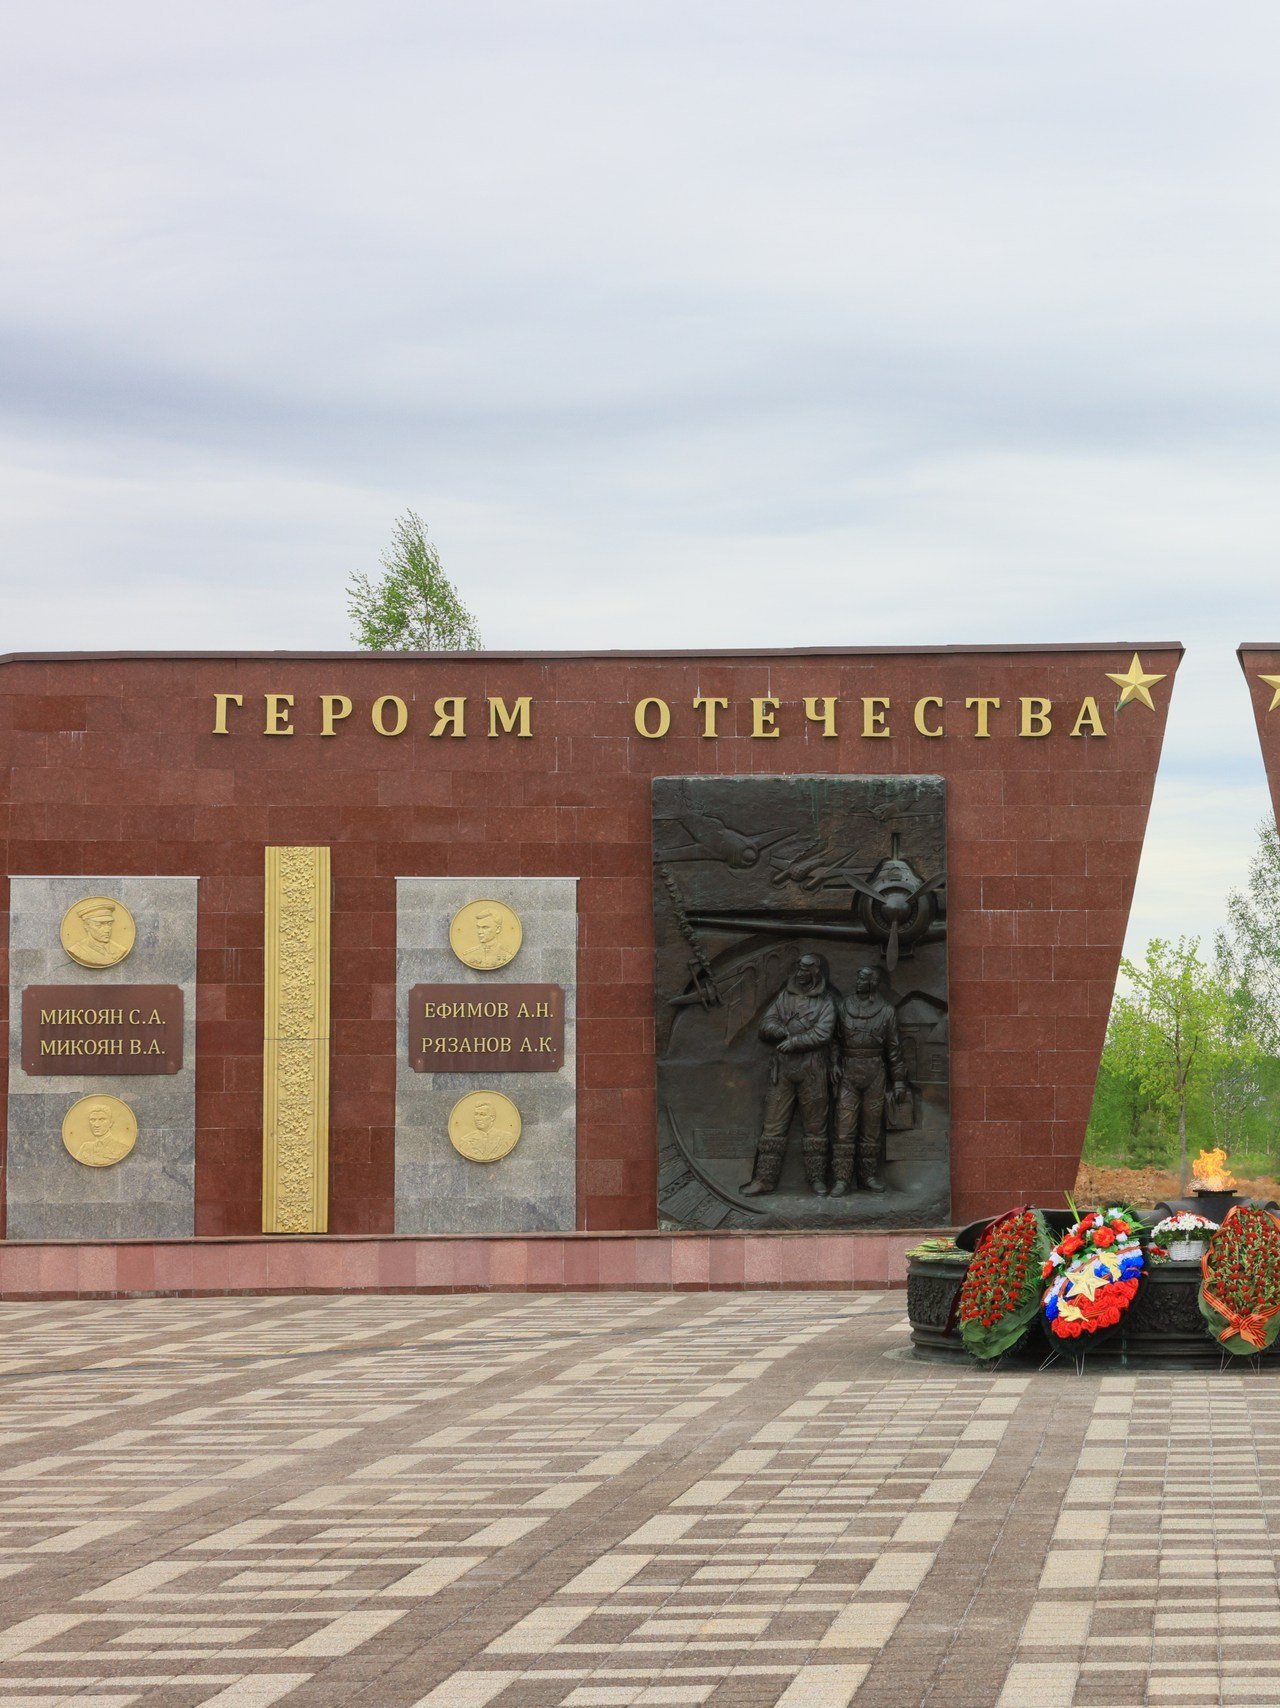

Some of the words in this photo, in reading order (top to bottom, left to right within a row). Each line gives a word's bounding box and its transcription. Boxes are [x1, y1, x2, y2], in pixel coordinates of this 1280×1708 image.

[211, 693, 533, 739] ГЕРОЯМ
[633, 696, 1107, 739] ОТЕЧЕСТВА
[40, 1009, 123, 1025] МИКОЯН
[128, 1009, 166, 1025] С.А.
[424, 1002, 509, 1018] ЕФИМОВ
[517, 1003, 554, 1018] А.Н.
[40, 1039, 123, 1056] МИКОЯН
[130, 1039, 165, 1055] В.А.
[421, 1037, 512, 1053] РЯЗАНОВ
[519, 1037, 557, 1053] А.К.
